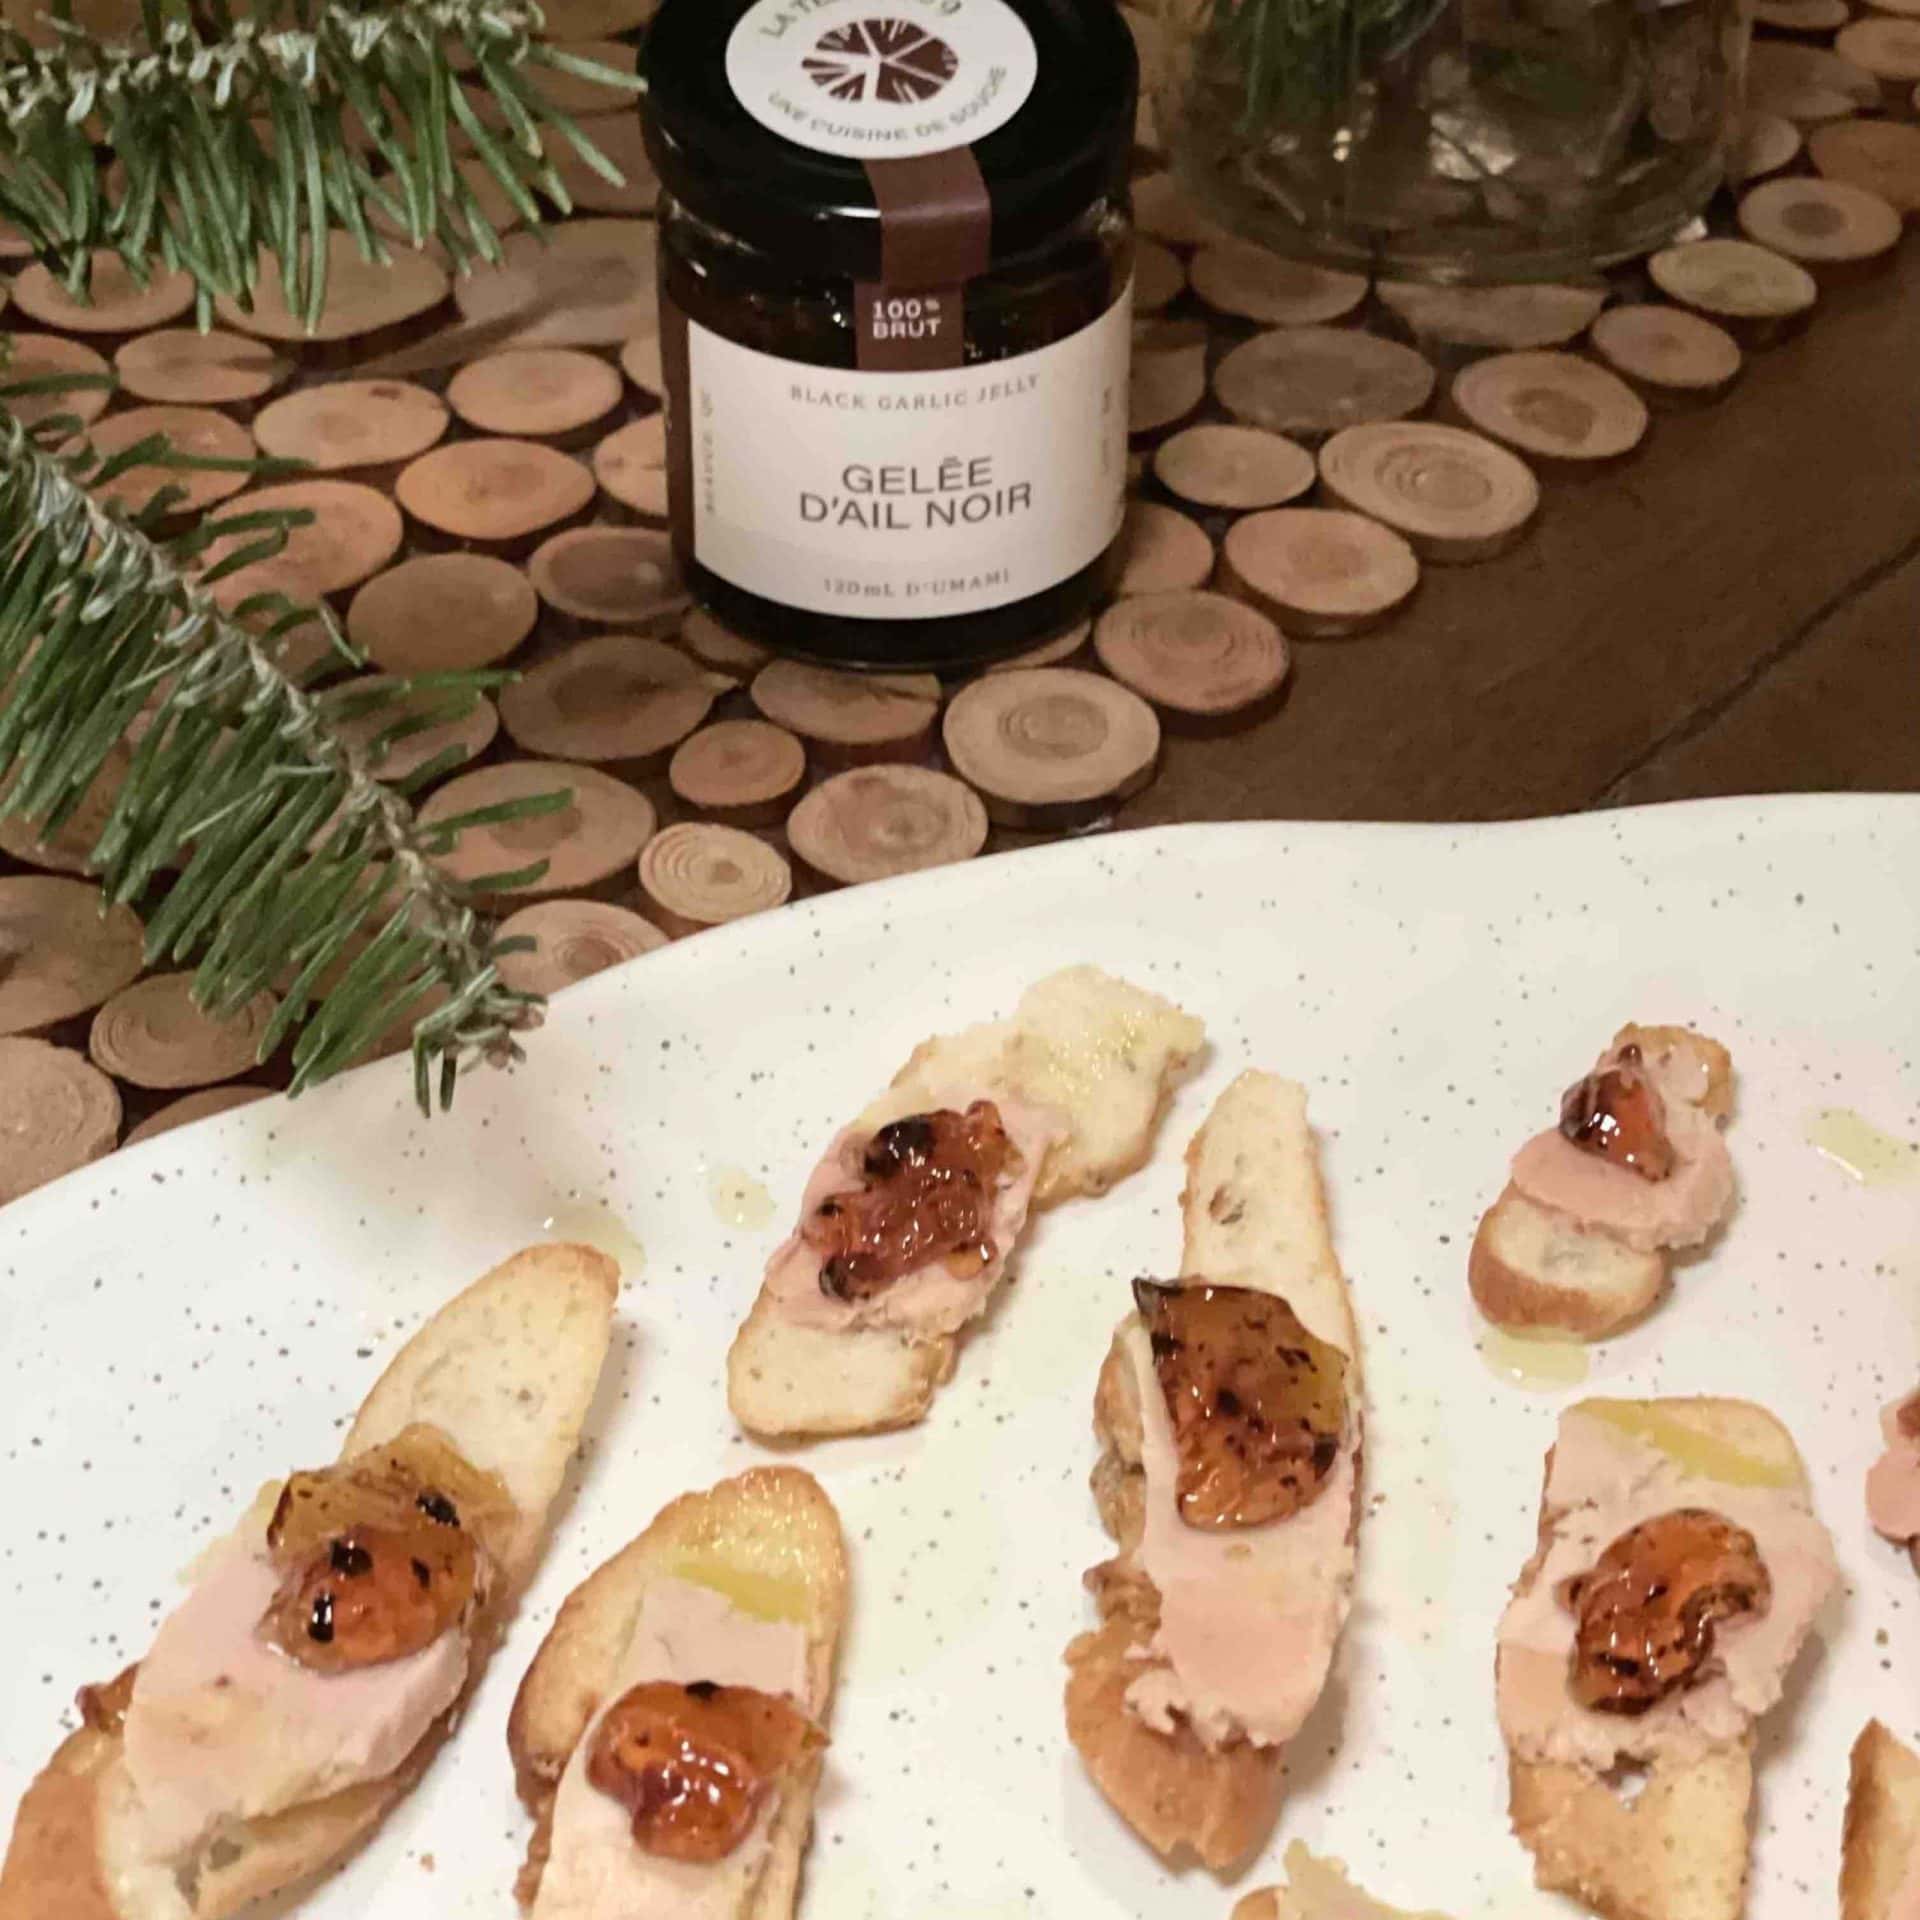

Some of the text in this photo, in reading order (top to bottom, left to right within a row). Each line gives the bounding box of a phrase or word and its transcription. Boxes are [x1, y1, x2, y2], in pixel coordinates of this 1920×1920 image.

[873, 317, 942, 339] BRUT
[790, 373, 1040, 411] BLACK GARLIC JELLY
[800, 481, 1032, 530] D'AIL NOIR
